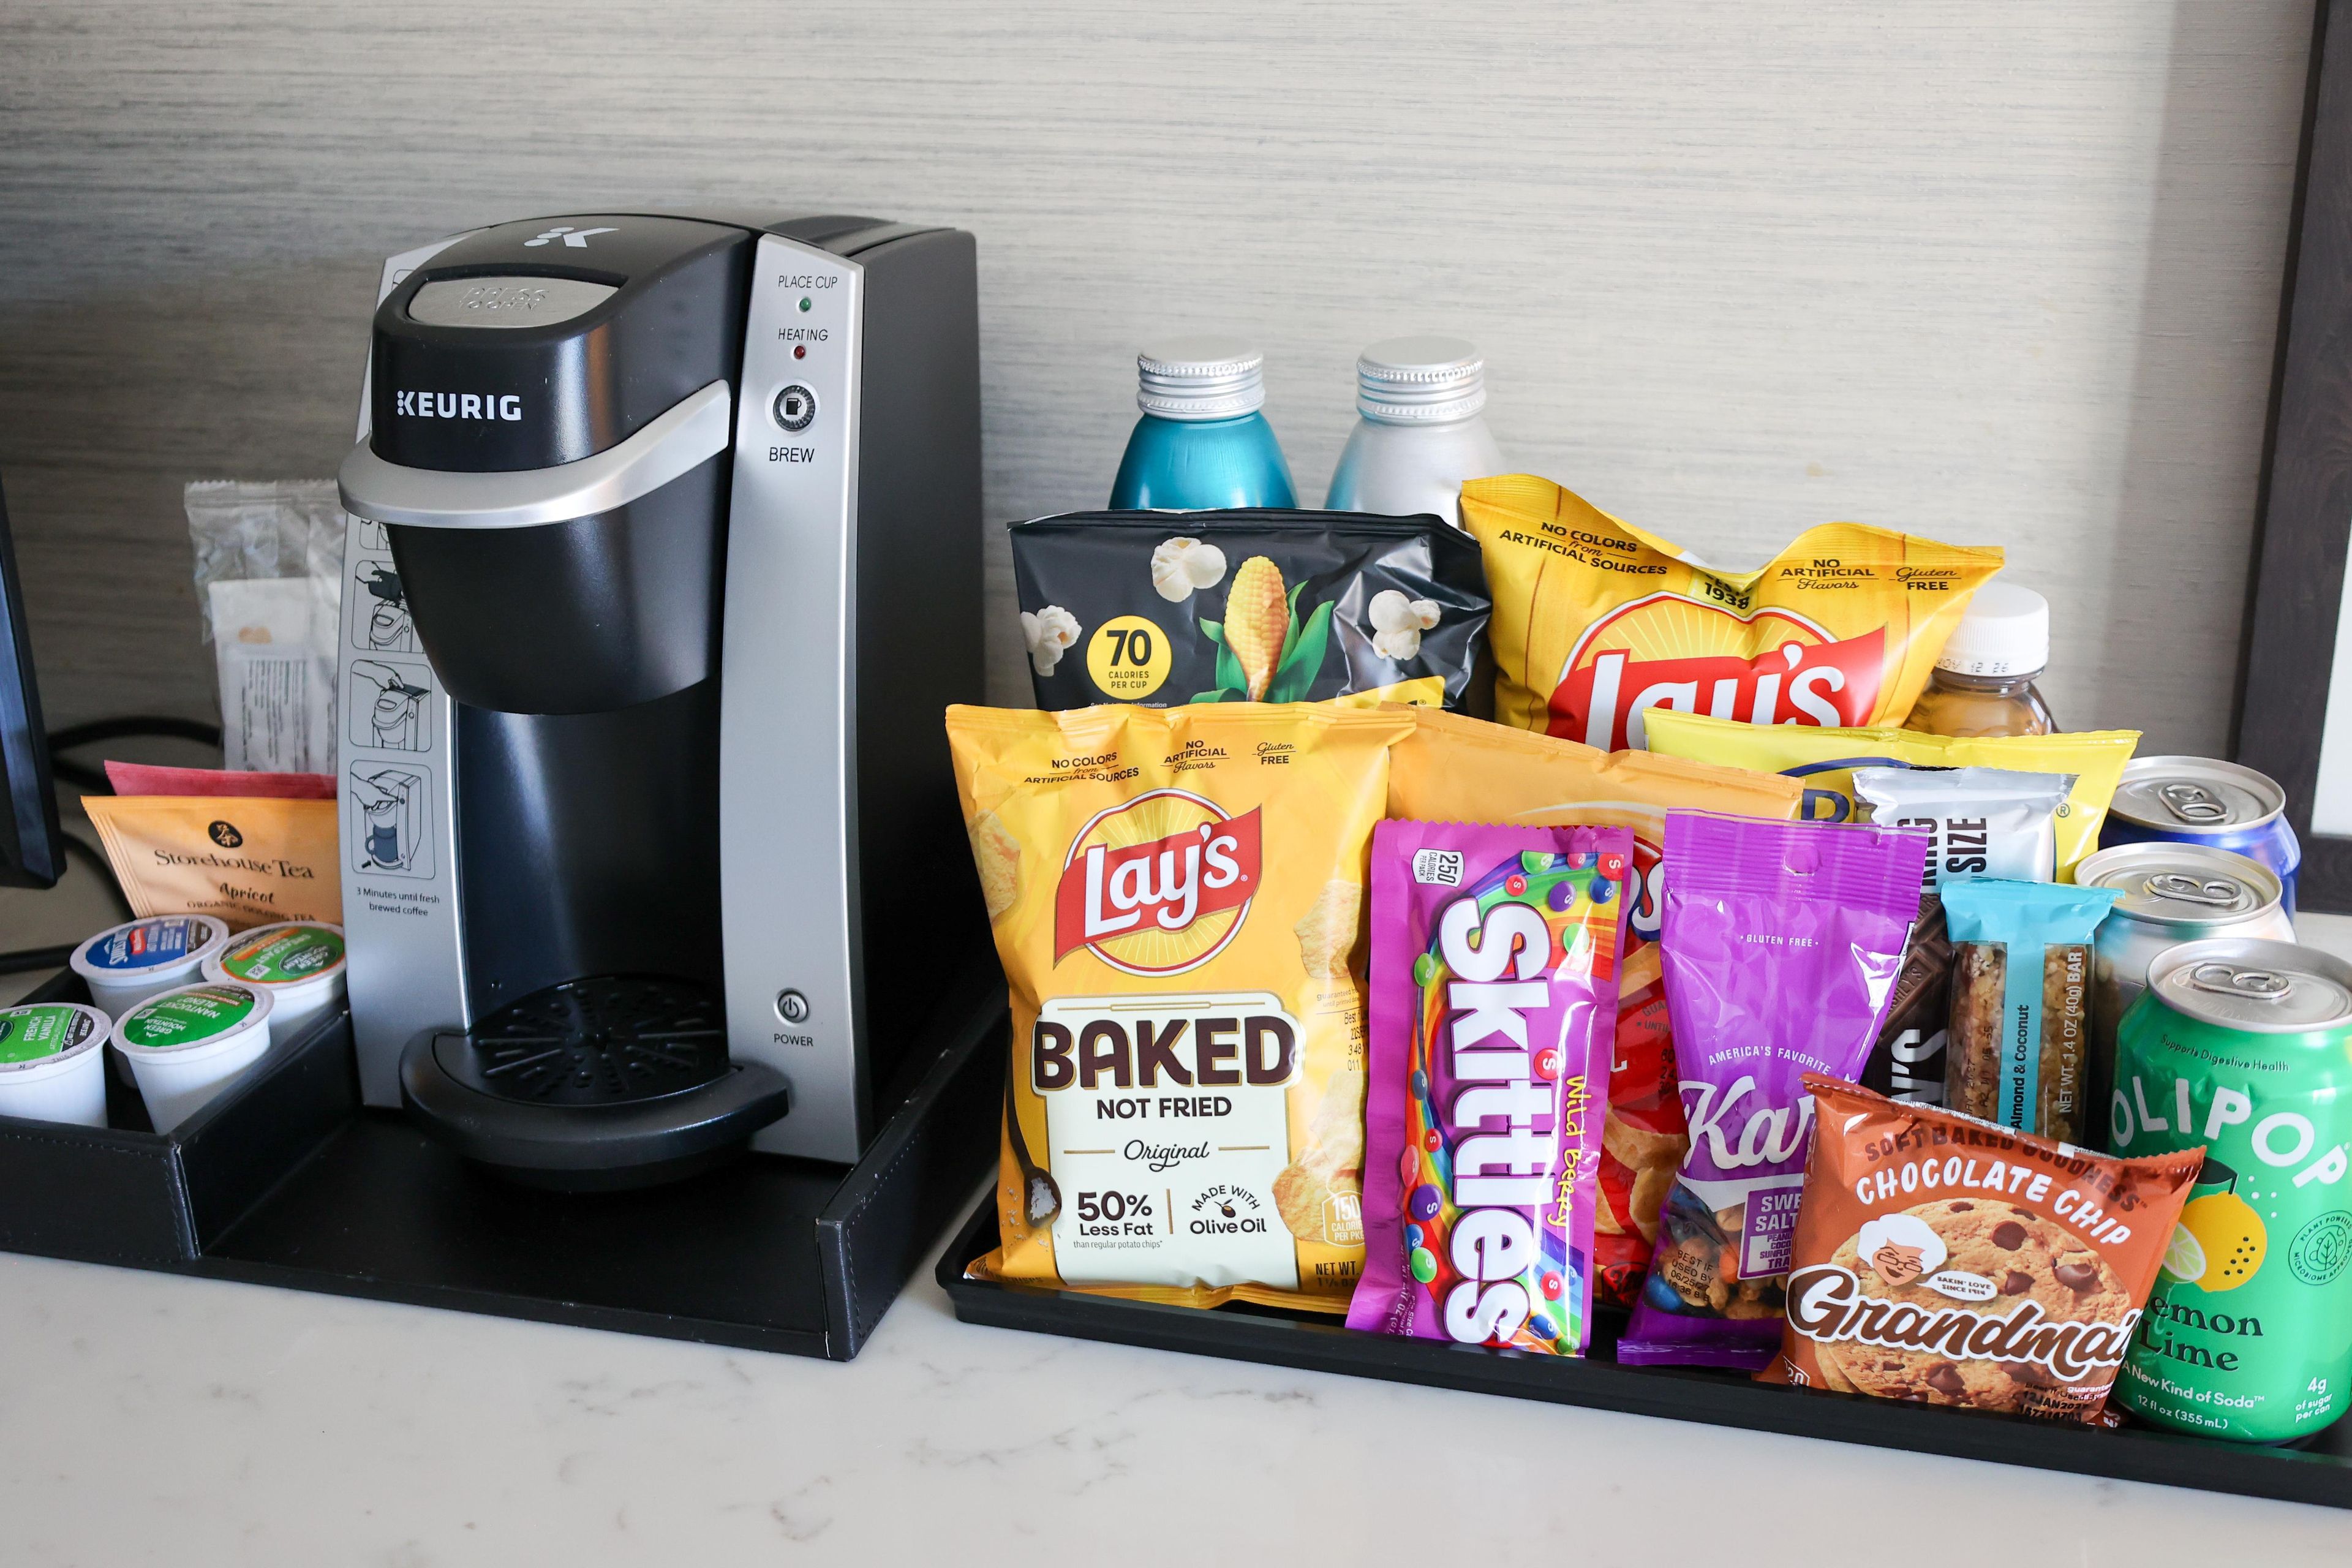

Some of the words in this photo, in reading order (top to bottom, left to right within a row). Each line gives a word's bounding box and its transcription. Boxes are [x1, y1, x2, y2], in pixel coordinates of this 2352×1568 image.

[778, 275, 812, 288] PLACE
[815, 276, 837, 288] CUP
[778, 328, 828, 341] HEATING
[397, 390, 522, 421] KEURIG
[769, 447, 815, 462] BREW
[1541, 522, 1567, 536] NO
[1570, 530, 1638, 552] COLORS
[1499, 529, 1586, 563] ARTIFICIAL
[1590, 557, 1668, 575] SOURCES
[1568, 540, 1604, 556] from
[1780, 568, 1875, 577] ARTIFICIAL
[1814, 559, 1841, 568] NO
[1796, 578, 1860, 590] Flavors
[1895, 567, 1958, 582] Gluten
[1705, 582, 1750, 610] 1938
[1907, 581, 1950, 590] FREE
[1107, 629, 1152, 667] 70
[1108, 671, 1149, 679] CALORIES
[1185, 739, 1204, 749] NO
[1256, 742, 1294, 756] Gluten
[1052, 759, 1069, 769] NO
[1072, 752, 1118, 767] COLORS
[1164, 747, 1227, 764] ARTIFICIAL
[1261, 755, 1289, 765] FREE
[1024, 773, 1087, 784] ARTIFICIAL
[1089, 767, 1139, 783] SOURCES
[1173, 761, 1216, 774] Flavors
[1947, 817, 1988, 873] SIZE
[154, 849, 273, 875] Storehouse
[272, 859, 315, 878] Tea
[1426, 852, 1438, 881] CALORIES
[1438, 854, 1458, 883] 250
[219, 882, 275, 905] Apricot
[363, 888, 397, 900] Minutes
[399, 892, 418, 902] until
[419, 892, 440, 903] fresh
[369, 901, 401, 913] brewed
[402, 907, 429, 916] coffee
[1747, 934, 1783, 945] GLUTEN
[1789, 937, 1813, 947] FREE
[2067, 951, 2082, 982] BAR
[1316, 987, 1351, 1001] guaranteed
[2065, 985, 2083, 1017] (40g)
[1344, 1011, 1356, 1025] Best
[2064, 1019, 2078, 1038] OZ
[774, 1033, 813, 1046] POWER
[2015, 1005, 2029, 1061] Coconut
[1035, 1016, 1297, 1090] BAKED
[1708, 1046, 1772, 1066] AMERICA'S
[1777, 1047, 1832, 1076] FAVORITE
[2063, 1041, 2075, 1060] 1.4
[2162, 1033, 2199, 1058] Supports
[2200, 1049, 2250, 1069] Digestive
[2253, 1060, 2290, 1072] Health
[2014, 1063, 2026, 1074] &
[2061, 1063, 2074, 1087] WT.
[1096, 1098, 1151, 1120] NOT
[1159, 1096, 1232, 1118] FRIED
[1565, 1074, 1586, 1137] Wild
[2010, 1077, 2025, 1129] Almond
[2059, 1090, 2072, 1114] NET
[1439, 897, 1556, 1344] Skittles
[2111, 1076, 2348, 1188] OLIPOP
[1864, 1126, 1923, 1162] SOFT
[1932, 1126, 2015, 1150] BAKED
[1123, 1139, 1210, 1172] Original
[1547, 1148, 1583, 1227] Berry
[1077, 1190, 1153, 1221] 50%
[1191, 1185, 1226, 1212] MADE
[1231, 1185, 1261, 1210] WITH
[1332, 1194, 1362, 1222] 150
[1856, 1156, 2053, 1205] CHOCOLATE
[2053, 1189, 2132, 1245] CHIP
[1079, 1223, 1120, 1236] Less
[1123, 1223, 1154, 1236] Fat
[1189, 1219, 1238, 1235] Olive
[1240, 1218, 1267, 1233] Oil
[1331, 1219, 1363, 1232] CALORIE
[1073, 1240, 1090, 1248] than
[1091, 1241, 1117, 1250] regular
[1118, 1240, 1141, 1249] potato
[1334, 1232, 1349, 1242] PER
[1315, 1262, 1336, 1276] NET
[1338, 1261, 1360, 1275] WT.
[1677, 1249, 1702, 1266] BEST
[1703, 1262, 1714, 1273] IF
[2294, 1251, 2327, 1281] MICROBIOME
[1672, 1260, 1696, 1278] USED
[1699, 1275, 1714, 1286] BY
[1937, 1276, 1967, 1285] BAKIN'
[1968, 1281, 1991, 1290] LOVE
[1942, 1284, 1966, 1293] SINCE
[2144, 1295, 2264, 1337] emon
[2137, 1319, 2240, 1372] Lime
[2122, 1360, 2130, 1374] A
[2132, 1366, 2160, 1389] New
[2161, 1378, 2193, 1400] Kind
[2195, 1390, 2212, 1405] of
[2307, 1376, 2328, 1395] 4g
[2137, 1394, 2148, 1407] 12
[2150, 1398, 2157, 1411] fl
[2158, 1406, 2173, 1417] oz
[2175, 1410, 2203, 1427] (355
[2205, 1418, 2229, 1430] mL)
[2295, 1398, 2308, 1412] of
[2308, 1393, 2333, 1411] sugar
[2295, 1408, 2313, 1423] per
[2314, 1403, 2331, 1416] can
